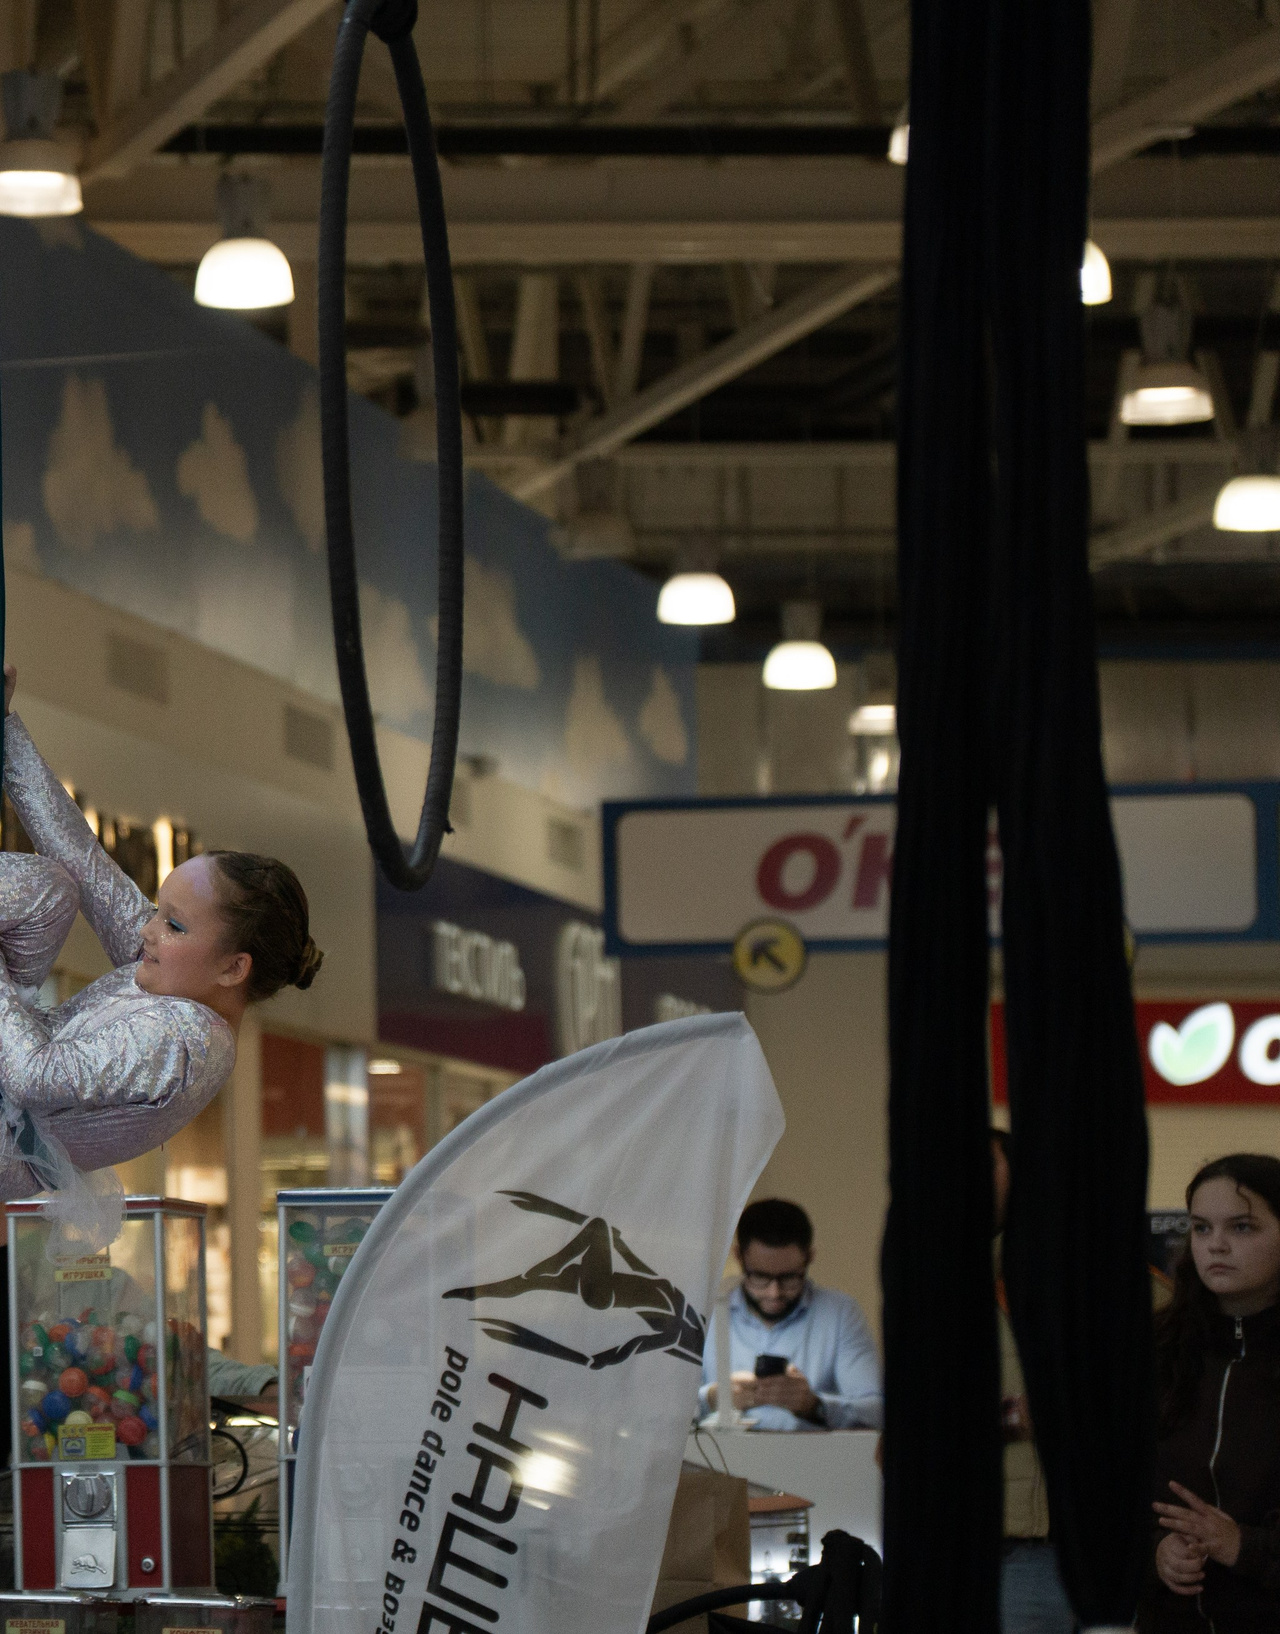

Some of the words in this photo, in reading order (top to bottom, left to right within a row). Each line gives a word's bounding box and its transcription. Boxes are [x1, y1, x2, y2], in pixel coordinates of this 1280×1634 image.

[62, 1270, 105, 1280] ИГРУШКА
[430, 1345, 469, 1423] pole
[399, 1430, 446, 1533] dance
[390, 1538, 417, 1564] &
[9, 1619, 60, 1629] ЖЕВАТЕЛЬНАЯ
